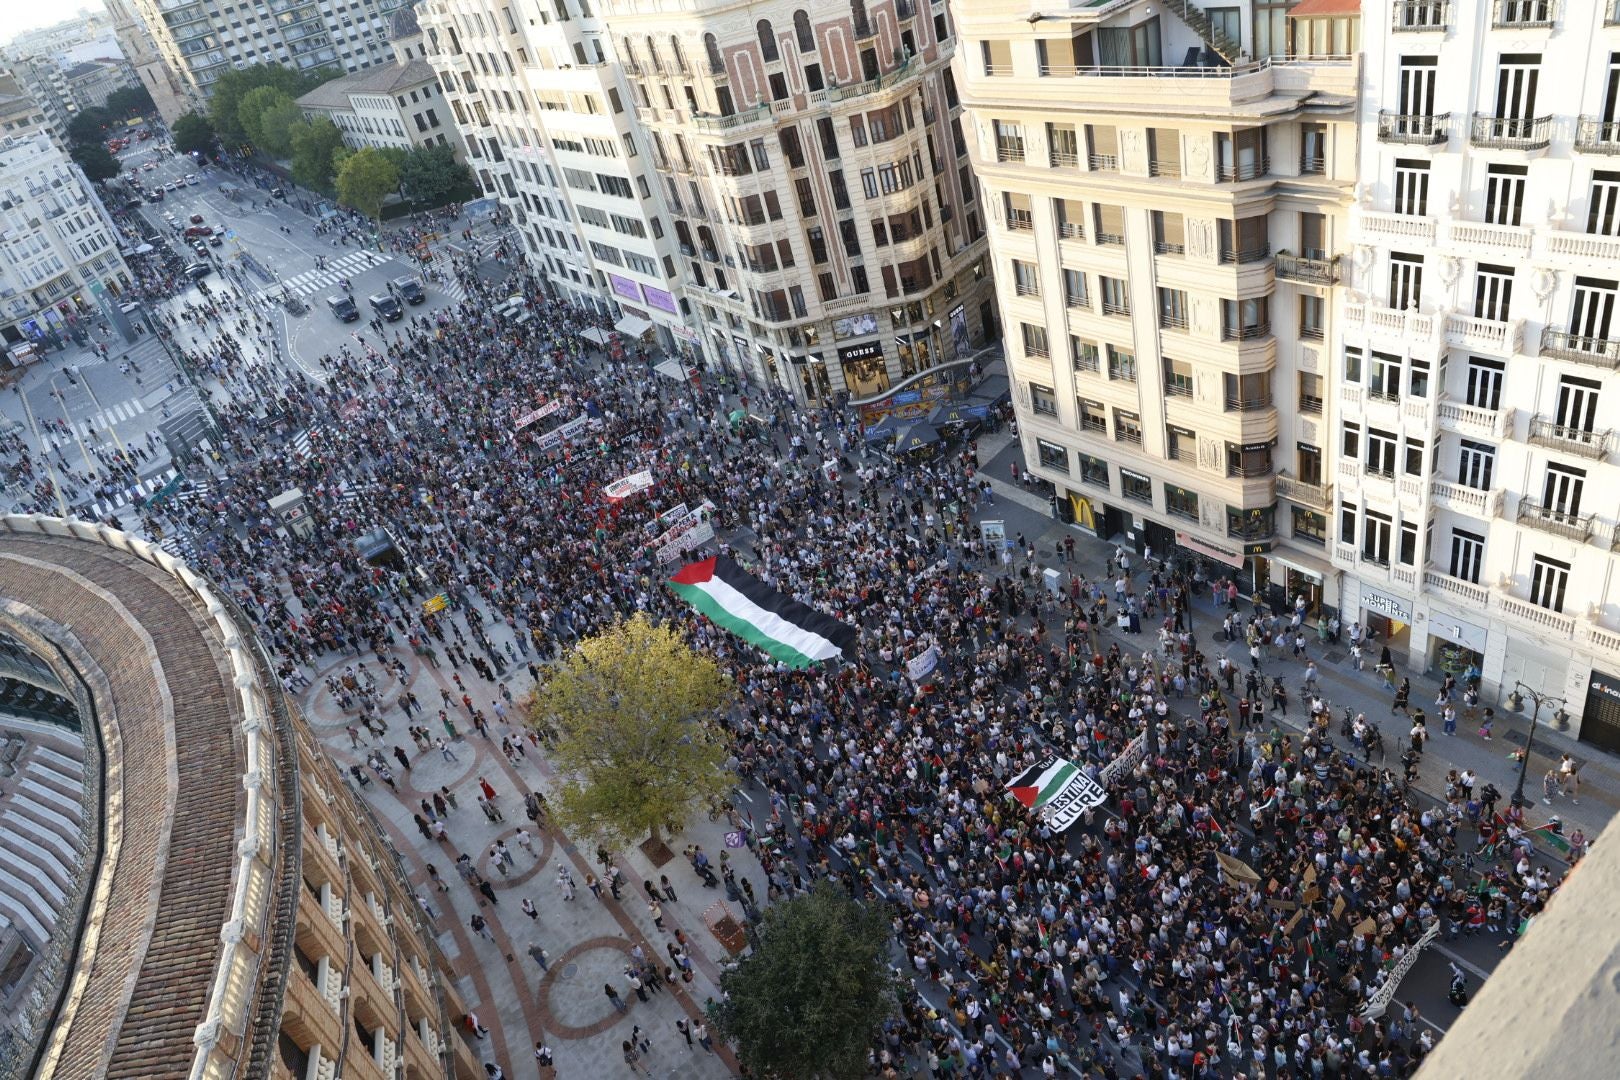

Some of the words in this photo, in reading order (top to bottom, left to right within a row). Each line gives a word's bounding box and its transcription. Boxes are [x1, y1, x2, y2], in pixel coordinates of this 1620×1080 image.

[846, 347, 874, 358] GUESS
[1361, 597, 1410, 620] MOMENTS
[1369, 593, 1399, 610] SUPER
[1053, 773, 1091, 812] LESTINA
[1049, 784, 1104, 831] LLIURE
